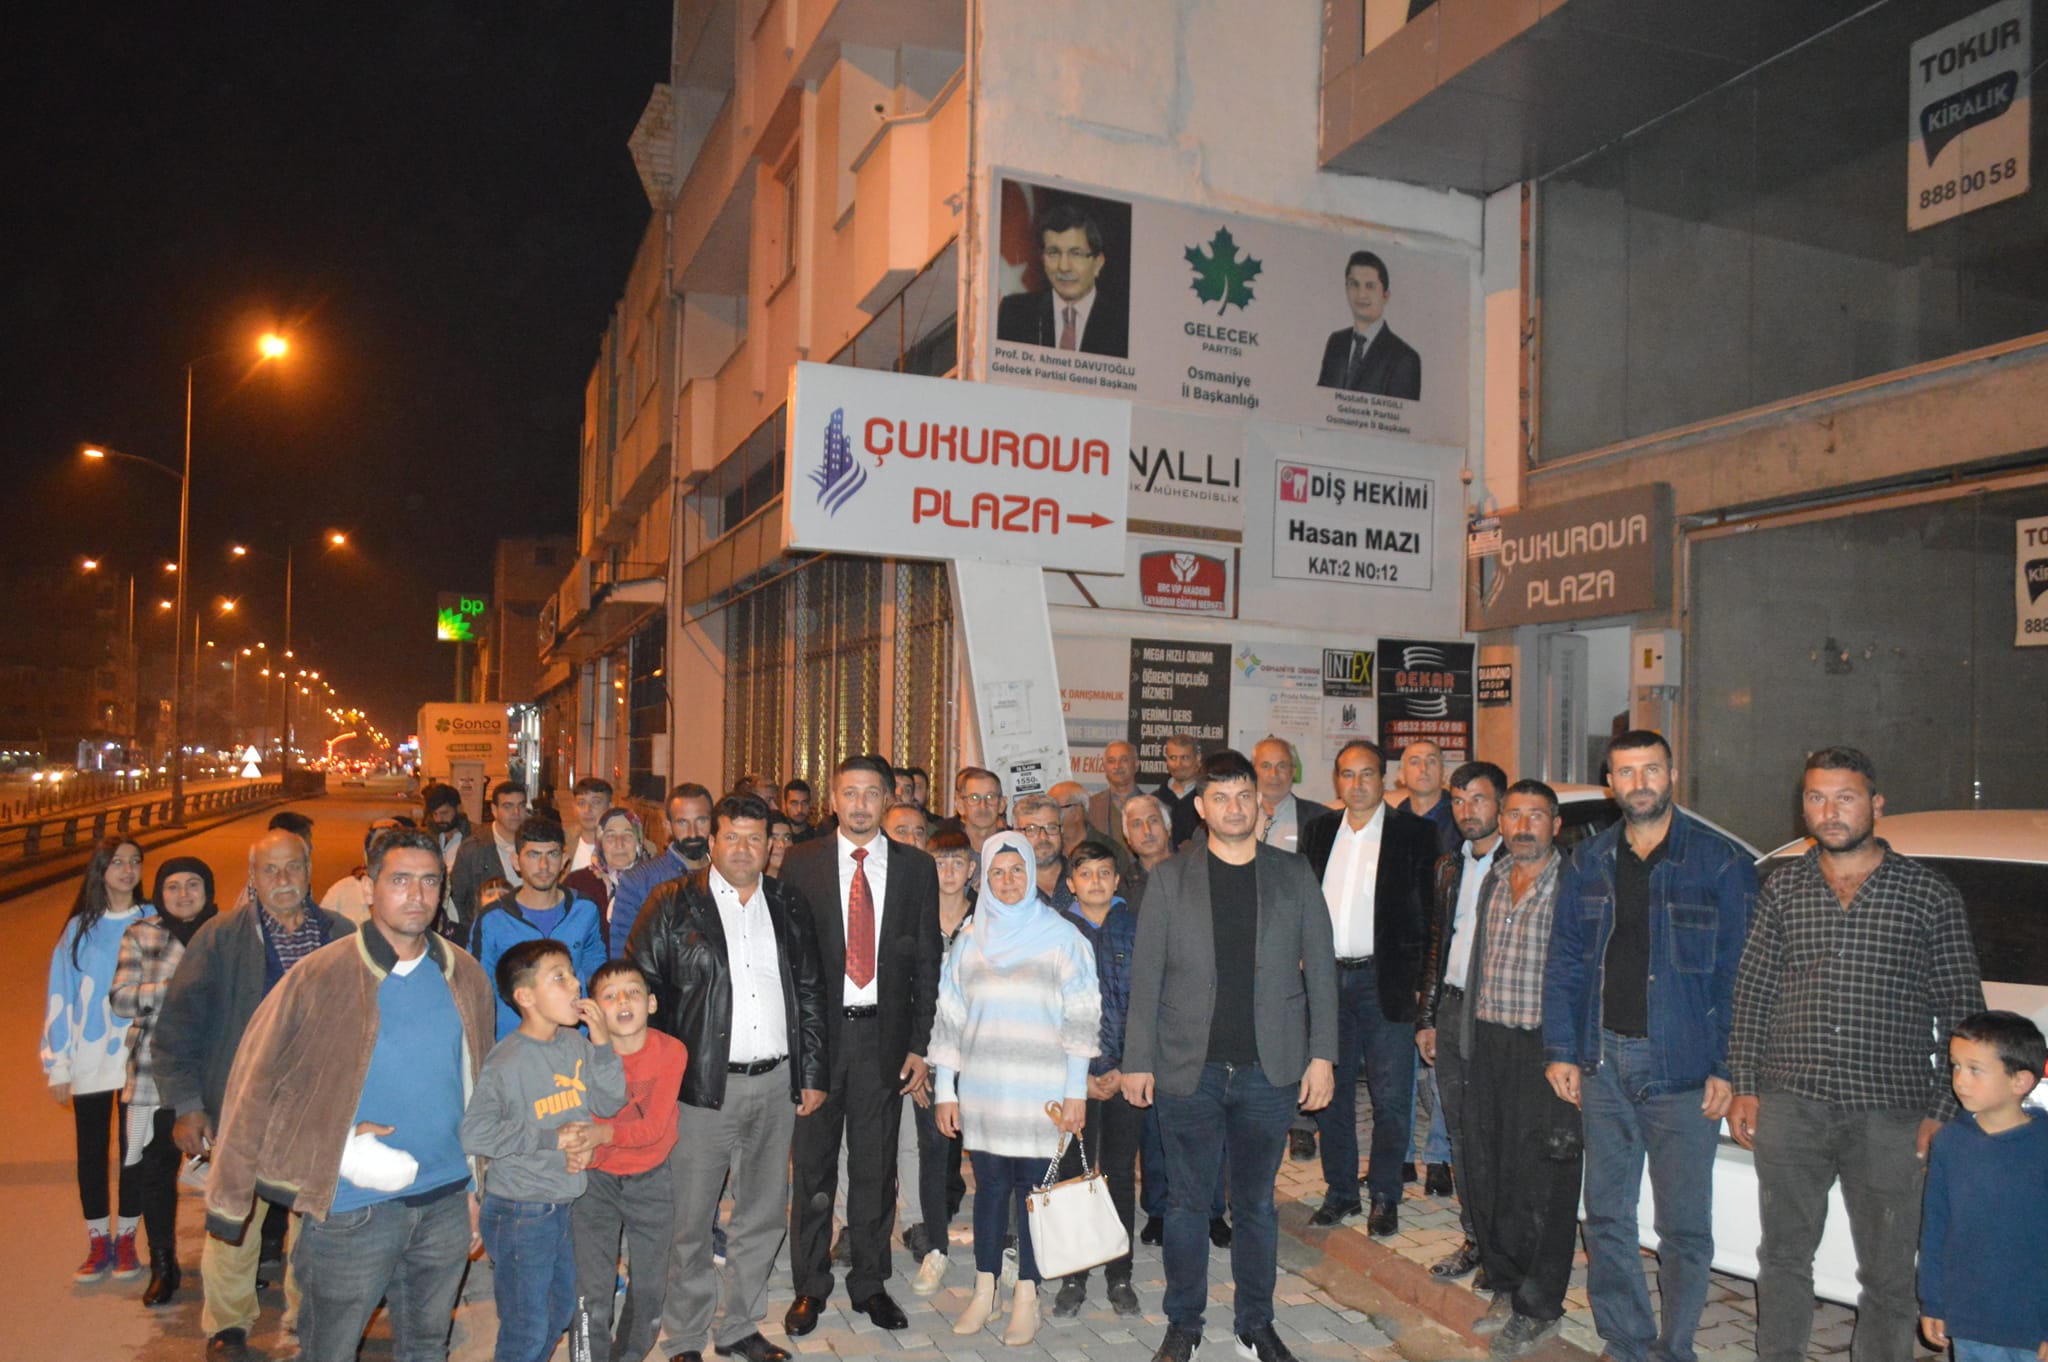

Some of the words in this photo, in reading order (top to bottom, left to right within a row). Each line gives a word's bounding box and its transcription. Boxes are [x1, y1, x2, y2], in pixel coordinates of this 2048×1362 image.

[1920, 18, 2020, 83] TOKUR
[1927, 82, 2009, 132] KİRALIK
[1920, 180, 1956, 209] 888
[1960, 171, 1986, 195] 00
[1989, 158, 2017, 185] 58
[1184, 322, 1259, 347] GELECEK
[995, 347, 1018, 360] Prof.
[1022, 352, 1036, 362] Dr.
[1040, 355, 1072, 368] Ahmet
[1075, 358, 1135, 376] DAVUTOĞLU
[992, 361, 1032, 376] Gelecek
[1035, 367, 1066, 382] Partisi
[1069, 373, 1098, 385] Genel
[1100, 377, 1138, 391] Başkanı
[1188, 366, 1252, 388] Osmaniye
[1193, 387, 1259, 409] Başkanlığı
[864, 417, 1110, 476] ÇUKUROVA
[1153, 484, 1240, 503] MÜHENDİSLİK
[1311, 472, 1346, 506] DİŞ
[1354, 480, 1428, 510] HEKİMİ
[912, 487, 1060, 535] PLAZA
[1288, 518, 1357, 549] Hasan
[1365, 527, 1420, 554] MAZI
[1501, 513, 1648, 574] ÇUKUROVA
[1308, 556, 1350, 578] KAT:2
[1355, 562, 1399, 582] NO:12
[1526, 569, 1616, 609] PLAZA
[461, 597, 484, 616] bp
[1143, 647, 1165, 661] MEGA
[1166, 649, 1185, 662] HIZLI
[1187, 650, 1213, 664] OKUMA
[1325, 650, 1373, 684] INTEX
[1142, 668, 1174, 684] ÖĞRENCİ
[1175, 671, 1208, 688] KOÇLUĞU
[1479, 667, 1510, 680] DIAMOND
[1141, 685, 1173, 700] HİZMETİ
[452, 718, 501, 730] Gonca
[1141, 706, 1171, 721] VERİMLİ
[1173, 710, 1192, 722] DERS
[1140, 723, 1174, 740] ÇALIŞMA
